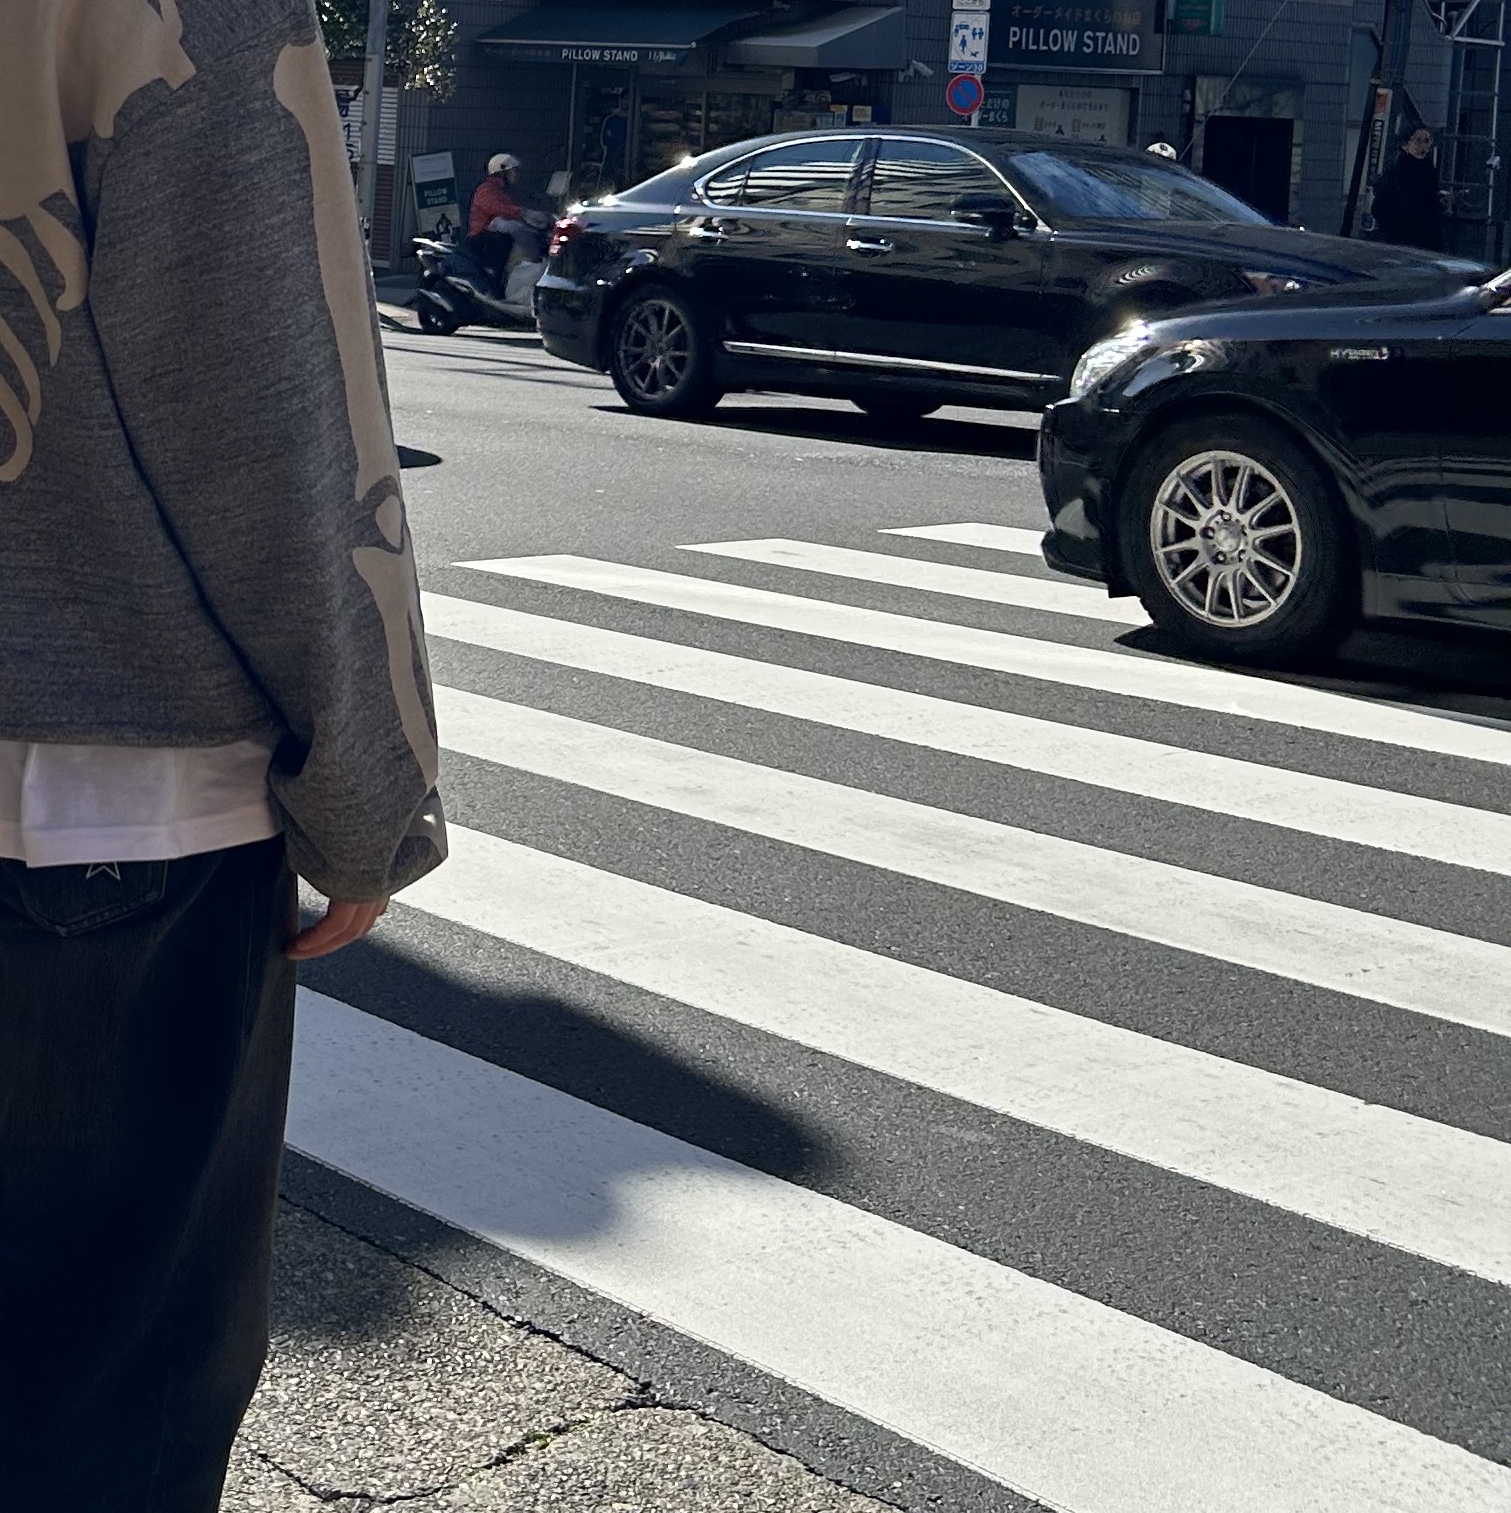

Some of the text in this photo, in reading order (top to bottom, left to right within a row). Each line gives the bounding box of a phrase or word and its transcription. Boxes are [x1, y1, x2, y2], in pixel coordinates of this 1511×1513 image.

[1008, 26, 1140, 55] PILLOW STAND
[561, 48, 602, 61] PILLOW
[603, 49, 638, 62] STAND
